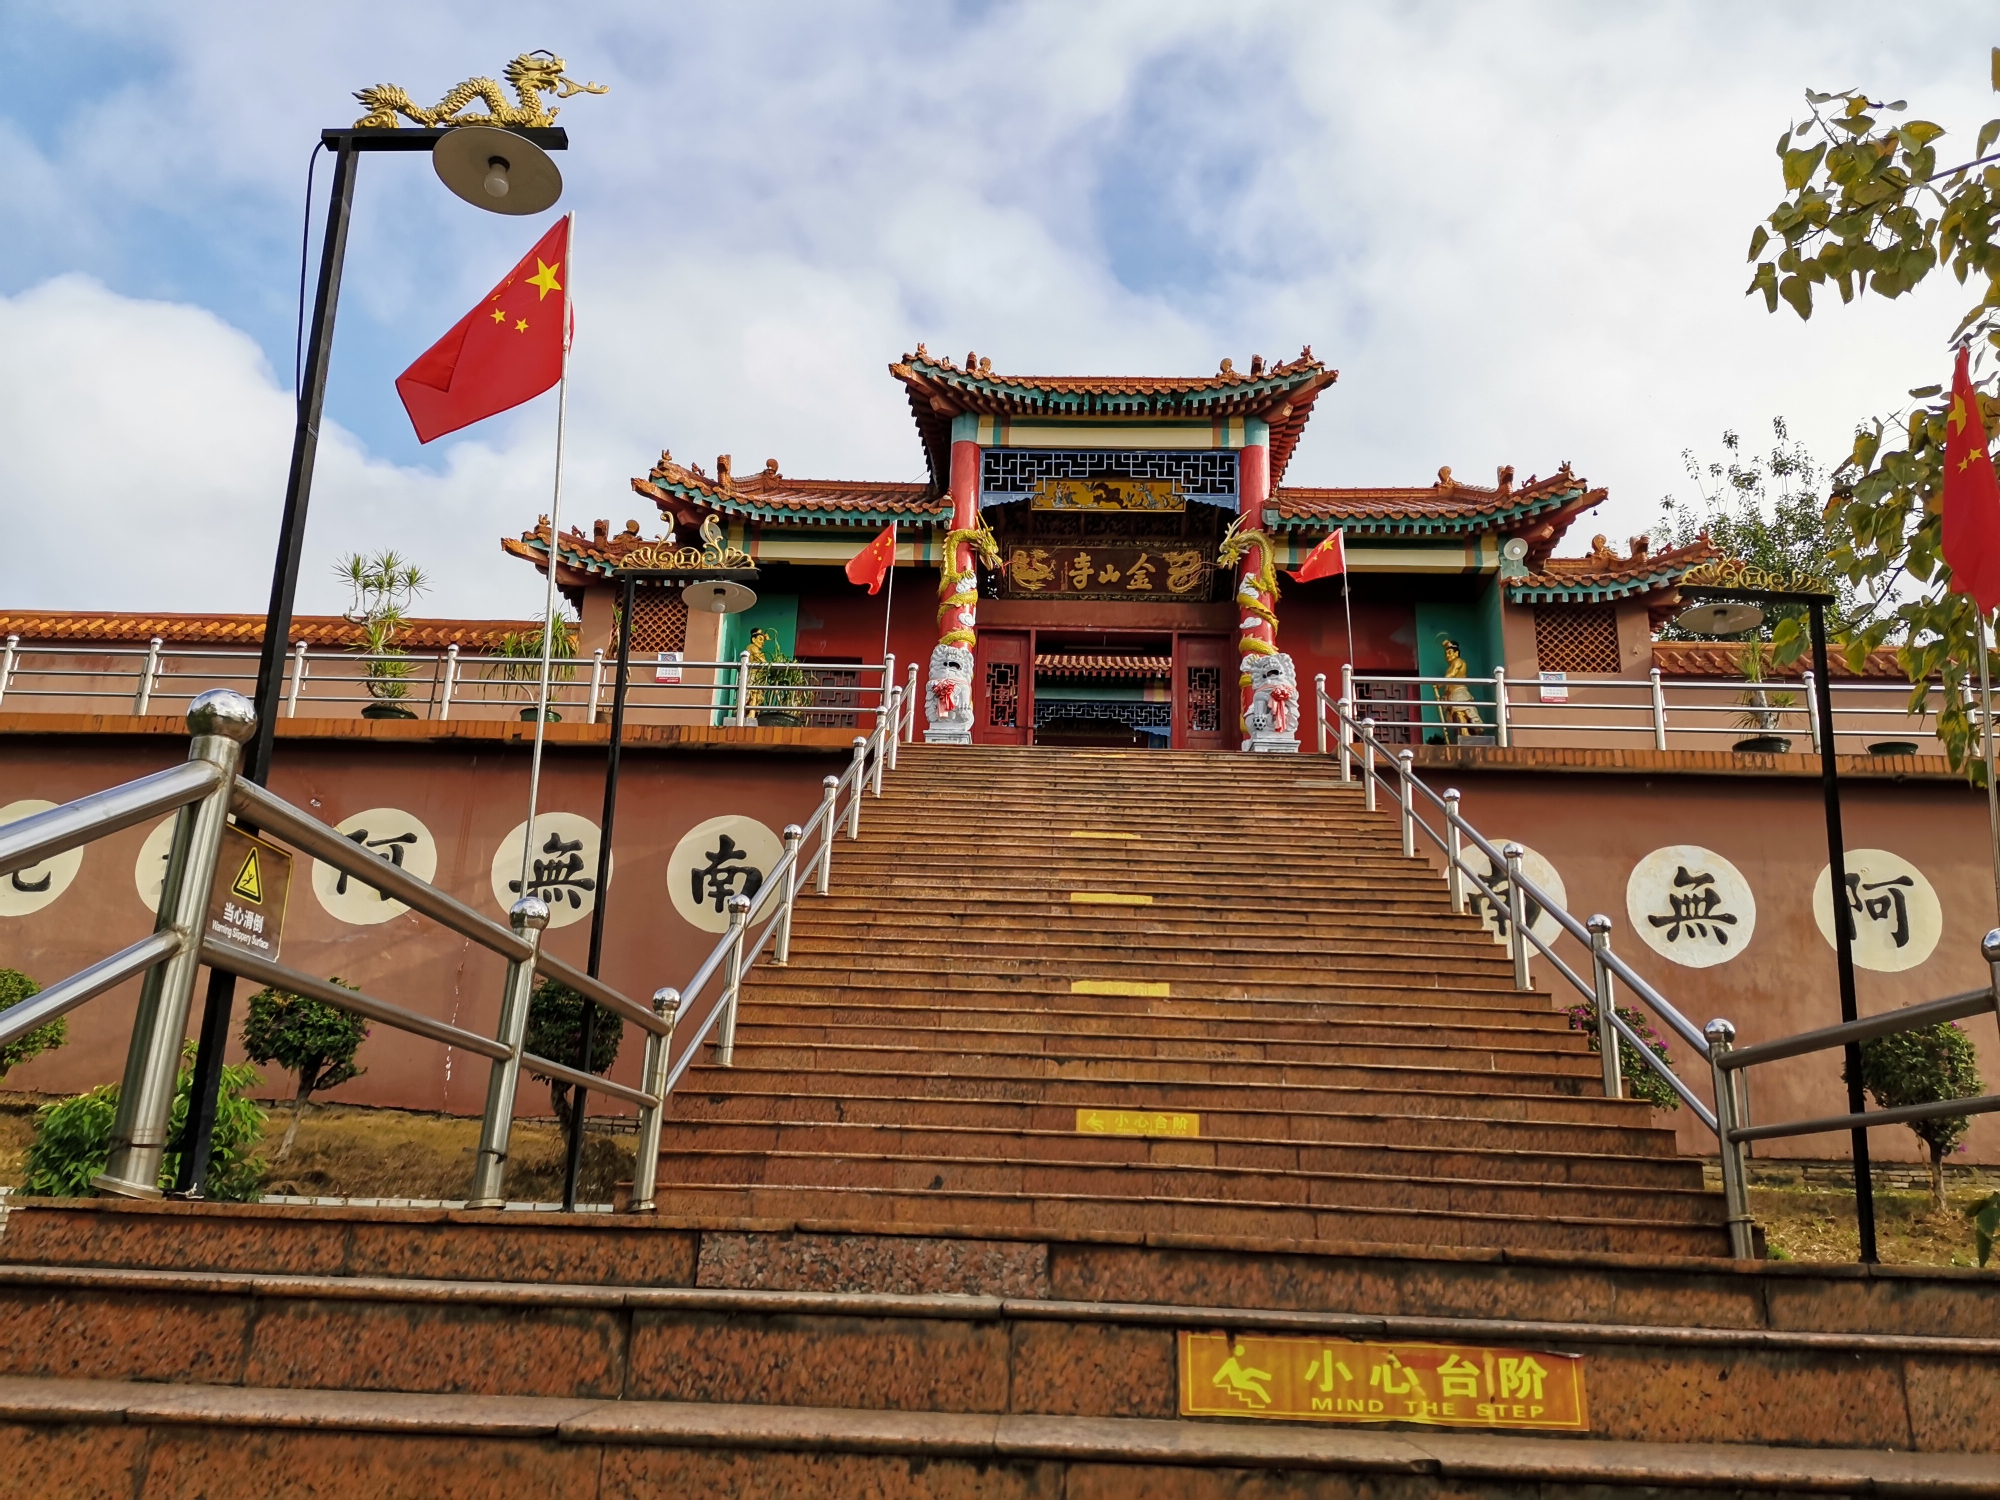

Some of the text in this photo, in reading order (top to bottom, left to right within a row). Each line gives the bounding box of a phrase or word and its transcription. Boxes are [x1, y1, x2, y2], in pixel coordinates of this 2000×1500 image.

[1068, 551, 1156, 591] 金山寺
[508, 832, 596, 910] 無
[691, 834, 763, 914] 南
[223, 902, 264, 933] 当心滑倒
[1647, 865, 1738, 946] 無
[1842, 872, 1914, 948] 阿
[212, 919, 269, 949] Warning Slippery Surface
[1114, 1114, 1188, 1130] 小心台阶
[1305, 1350, 1548, 1400] 小心台阶
[1311, 1397, 1545, 1419] MIND THE STEP
